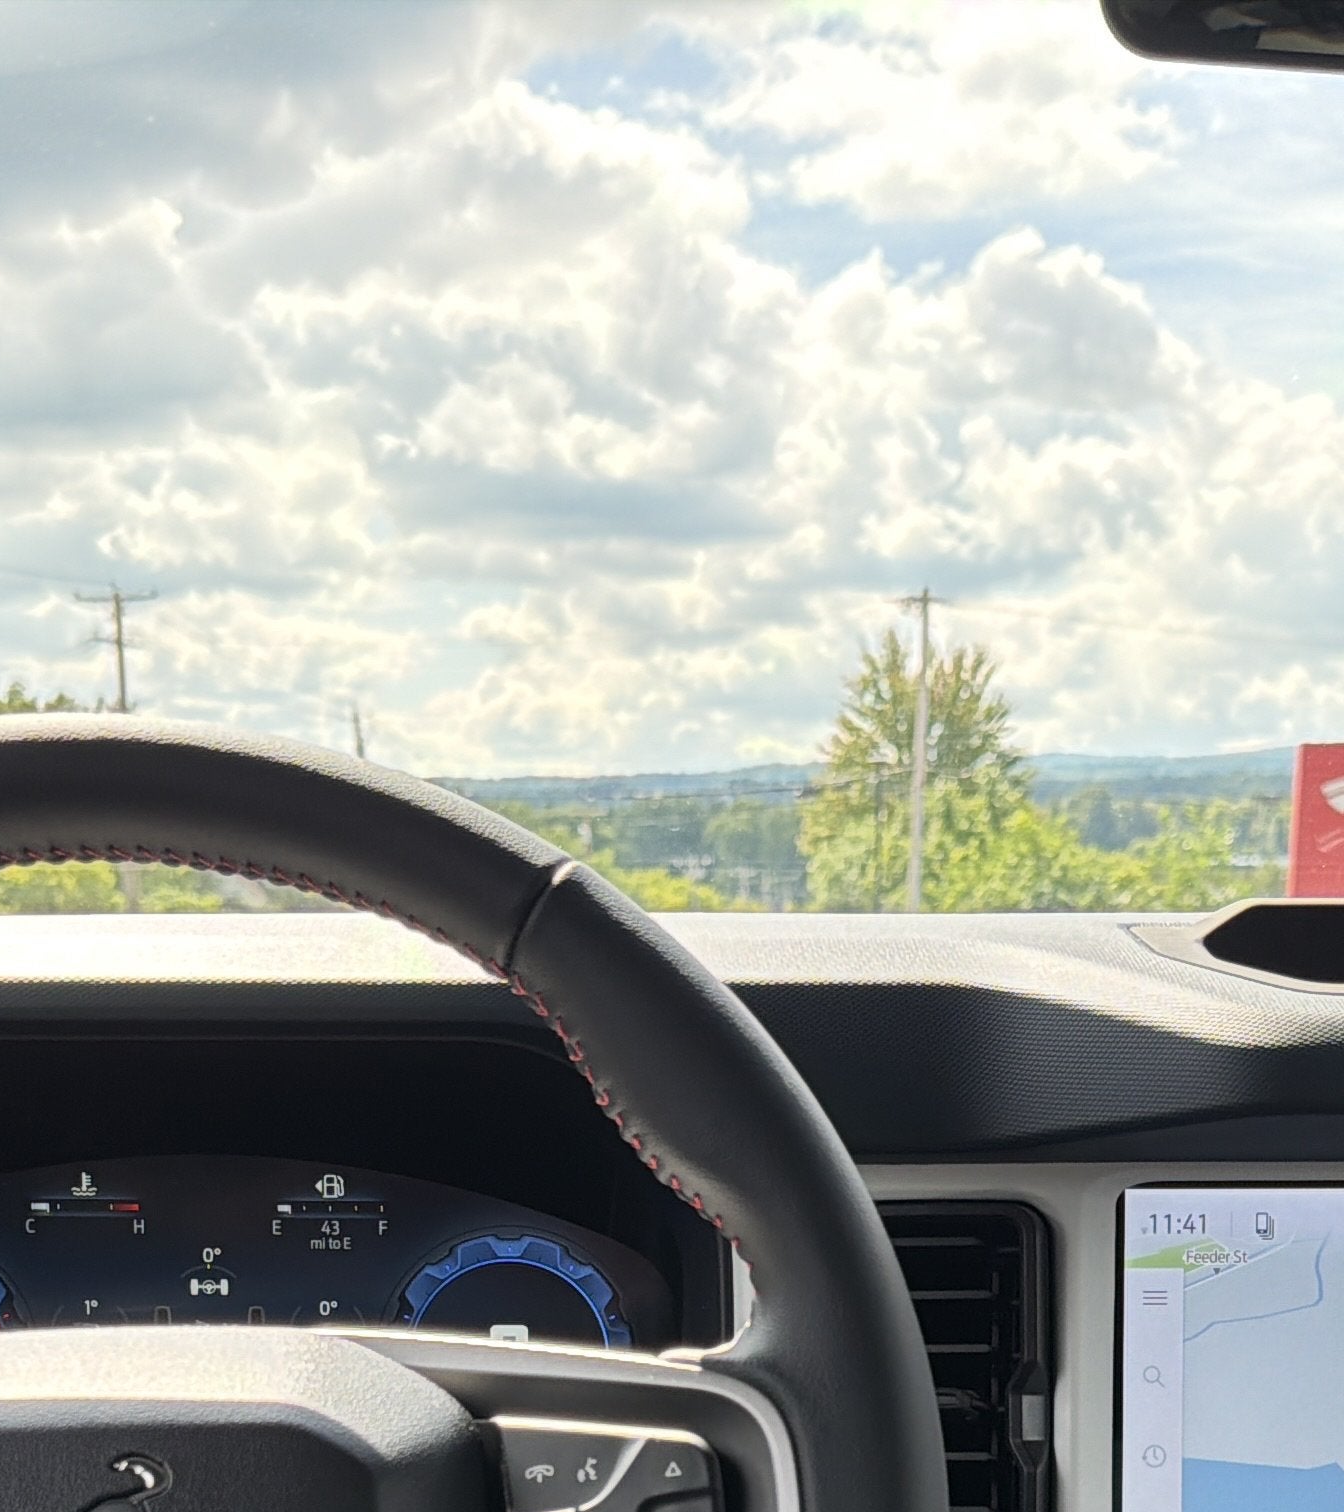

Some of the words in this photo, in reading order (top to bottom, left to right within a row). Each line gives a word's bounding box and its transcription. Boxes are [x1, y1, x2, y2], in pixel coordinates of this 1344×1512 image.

[25, 1218, 37, 1234] C
[133, 1218, 145, 1235] H
[272, 1220, 283, 1236] E
[321, 1220, 341, 1236] 43
[378, 1220, 389, 1236] F
[1148, 1212, 1207, 1235] 11:41
[310, 1237, 325, 1250] mi
[327, 1237, 340, 1250] to
[343, 1237, 352, 1250] E
[1185, 1249, 1230, 1265] Feeder
[1233, 1249, 1248, 1265] St
